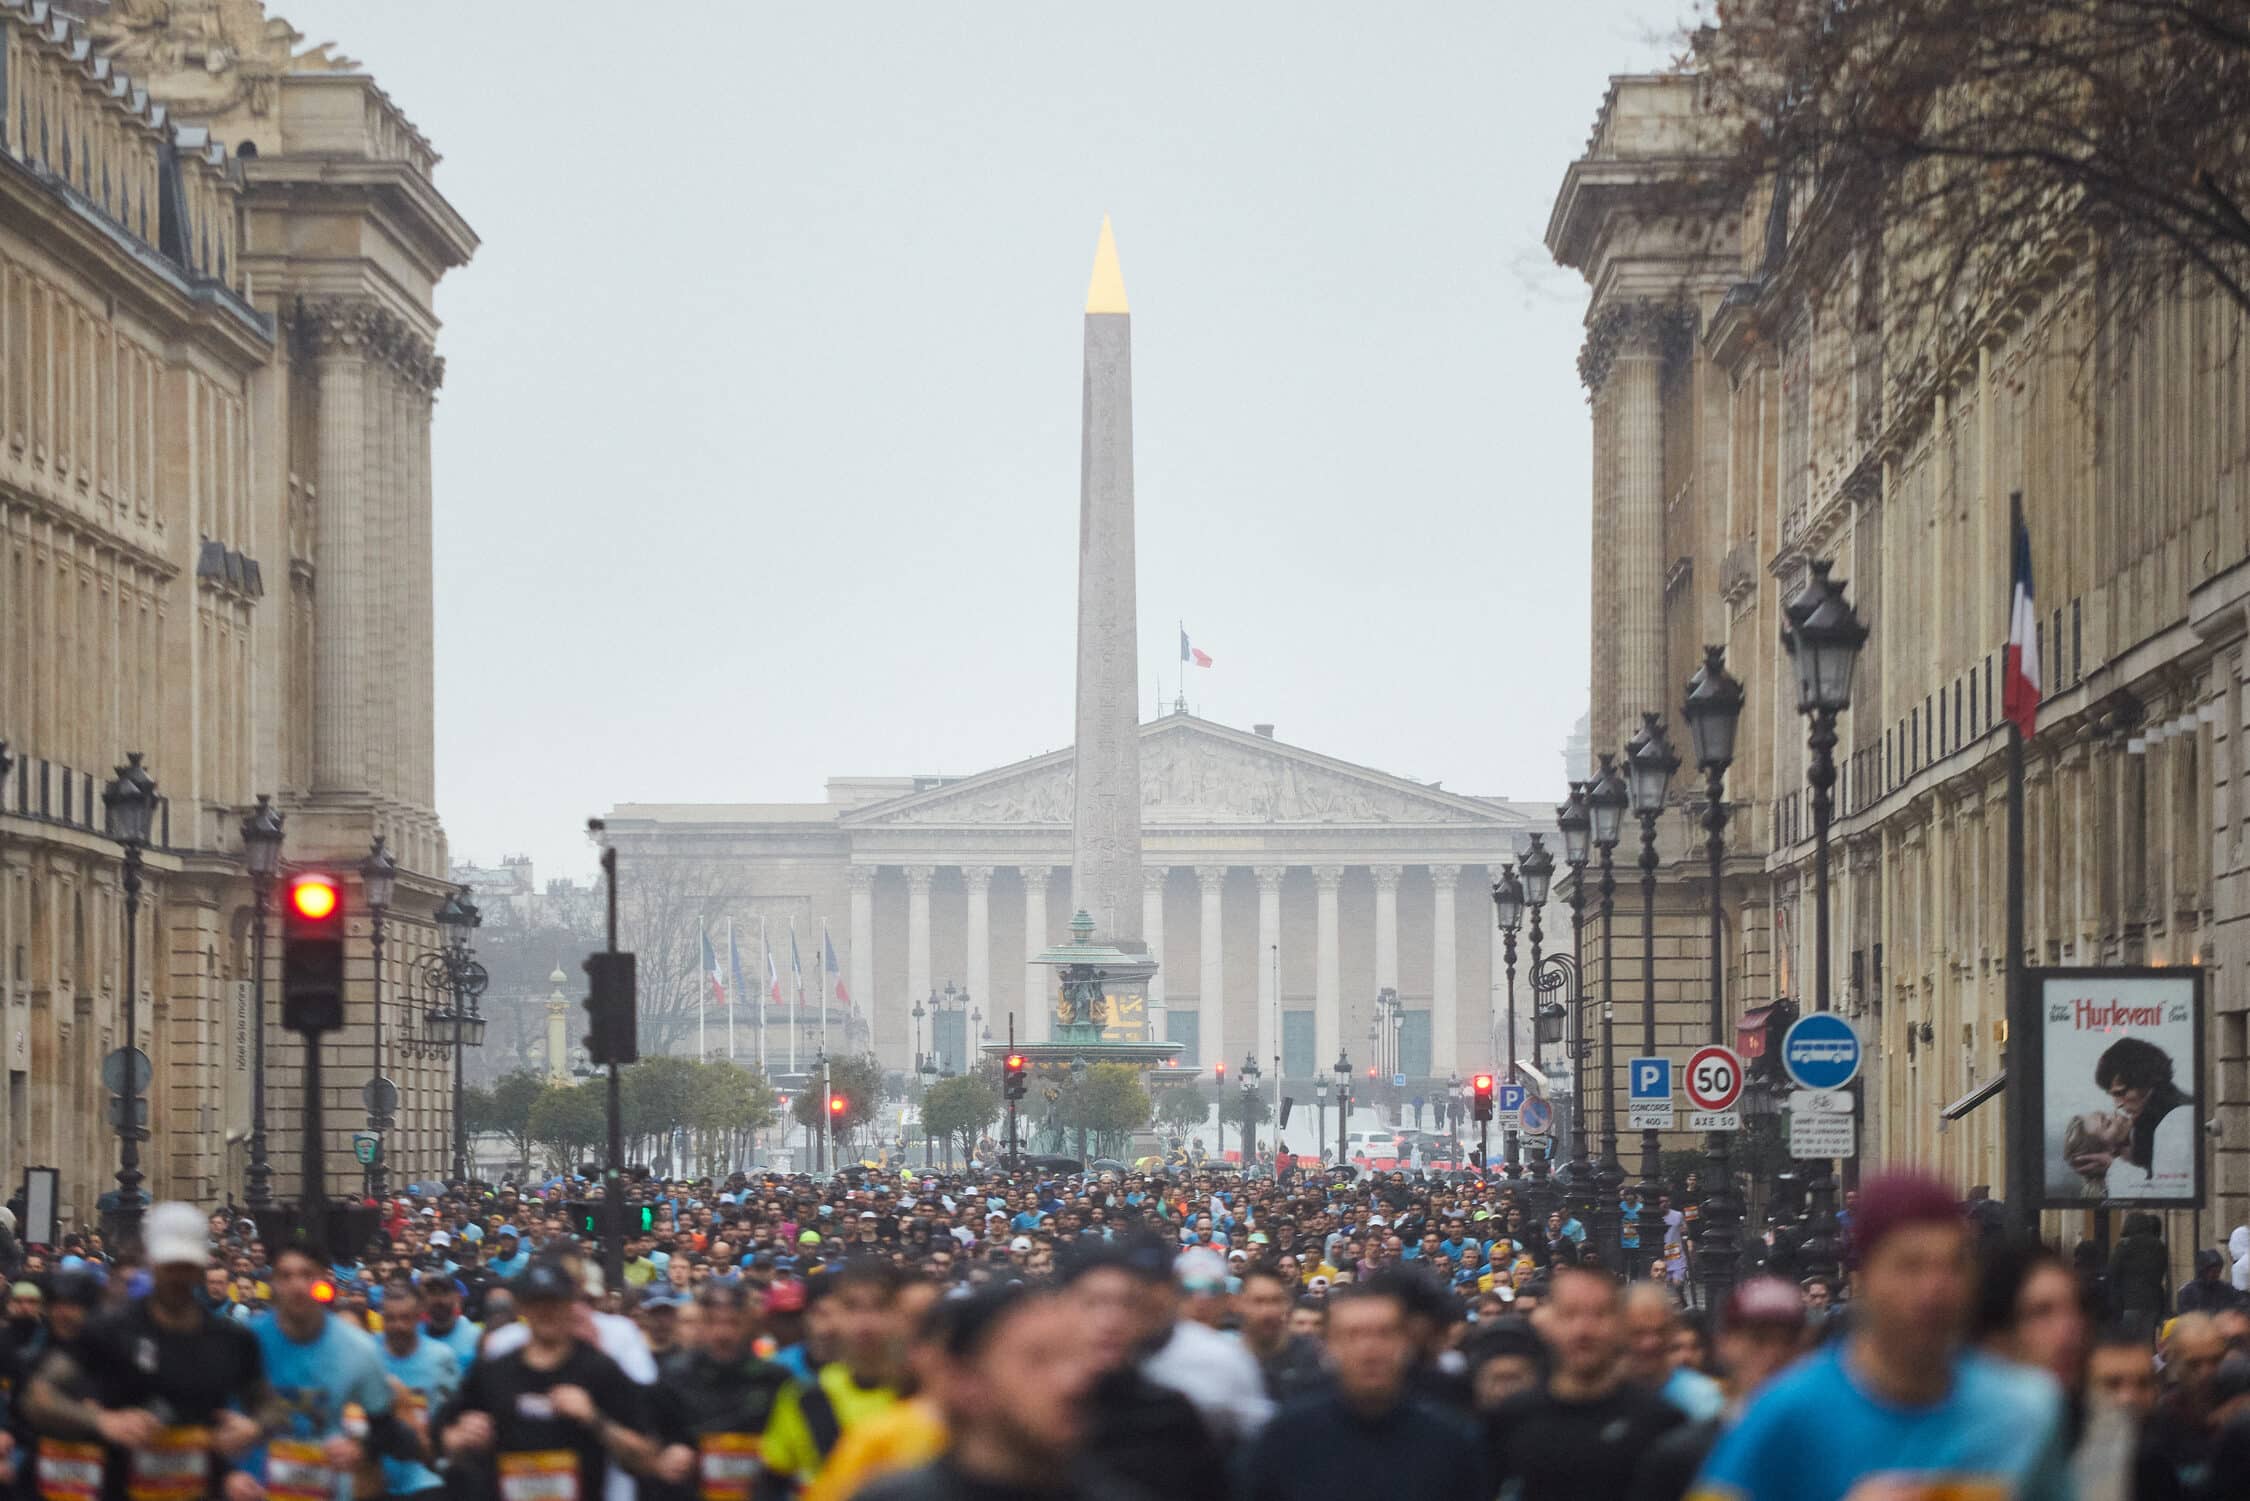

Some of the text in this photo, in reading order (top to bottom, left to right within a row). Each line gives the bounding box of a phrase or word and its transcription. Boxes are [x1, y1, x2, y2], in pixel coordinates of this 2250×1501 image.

[1640, 1066, 1660, 1092] P
[1697, 1066, 1731, 1093] 50
[1506, 1090, 1518, 1107] P
[1630, 1103, 1672, 1112] CONCORDE
[1645, 1117, 1661, 1127] 400
[1694, 1117, 1736, 1127] AXE 50
